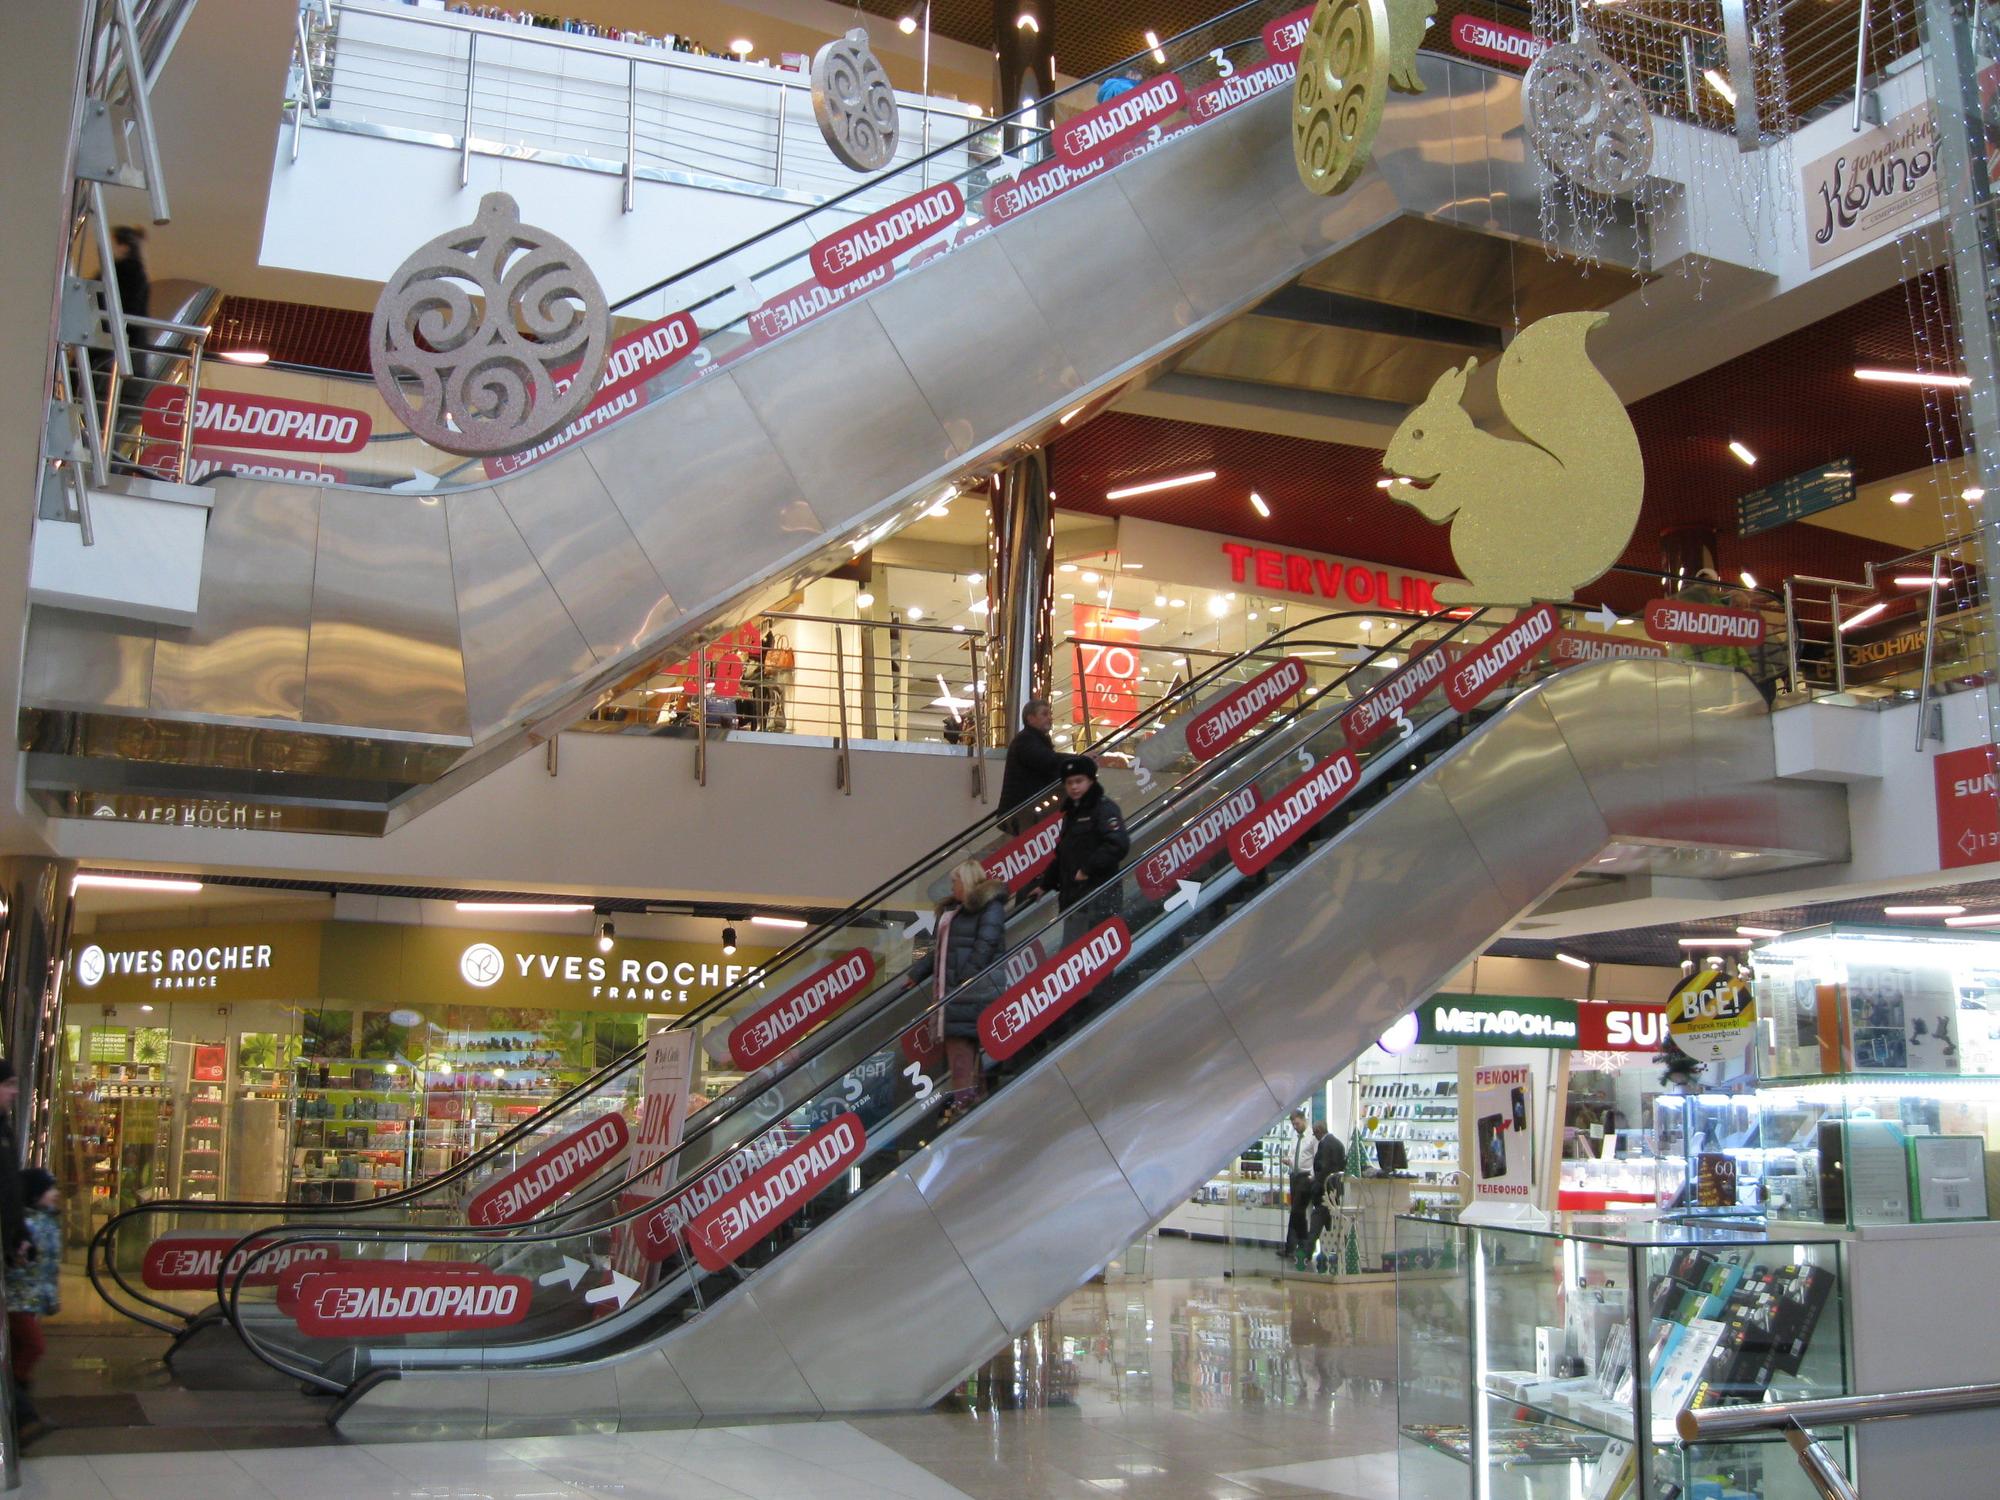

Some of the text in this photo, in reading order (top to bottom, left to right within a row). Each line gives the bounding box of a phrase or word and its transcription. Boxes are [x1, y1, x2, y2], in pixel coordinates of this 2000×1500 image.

[1222, 542, 1472, 618] TERVOLIN
[1850, 628, 1944, 666] ЭКОНИК
[108, 945, 272, 975] YVES ROCHER
[516, 953, 766, 989] YVES ROCHER
[154, 976, 217, 989] FRANCE
[593, 985, 689, 1002] FRANCE
[1682, 981, 1739, 1019] ВСЁ!
[1476, 1069, 1528, 1085] РЕМОНТ
[1477, 1184, 1528, 1195] ТЕЛЕФОНОВ
